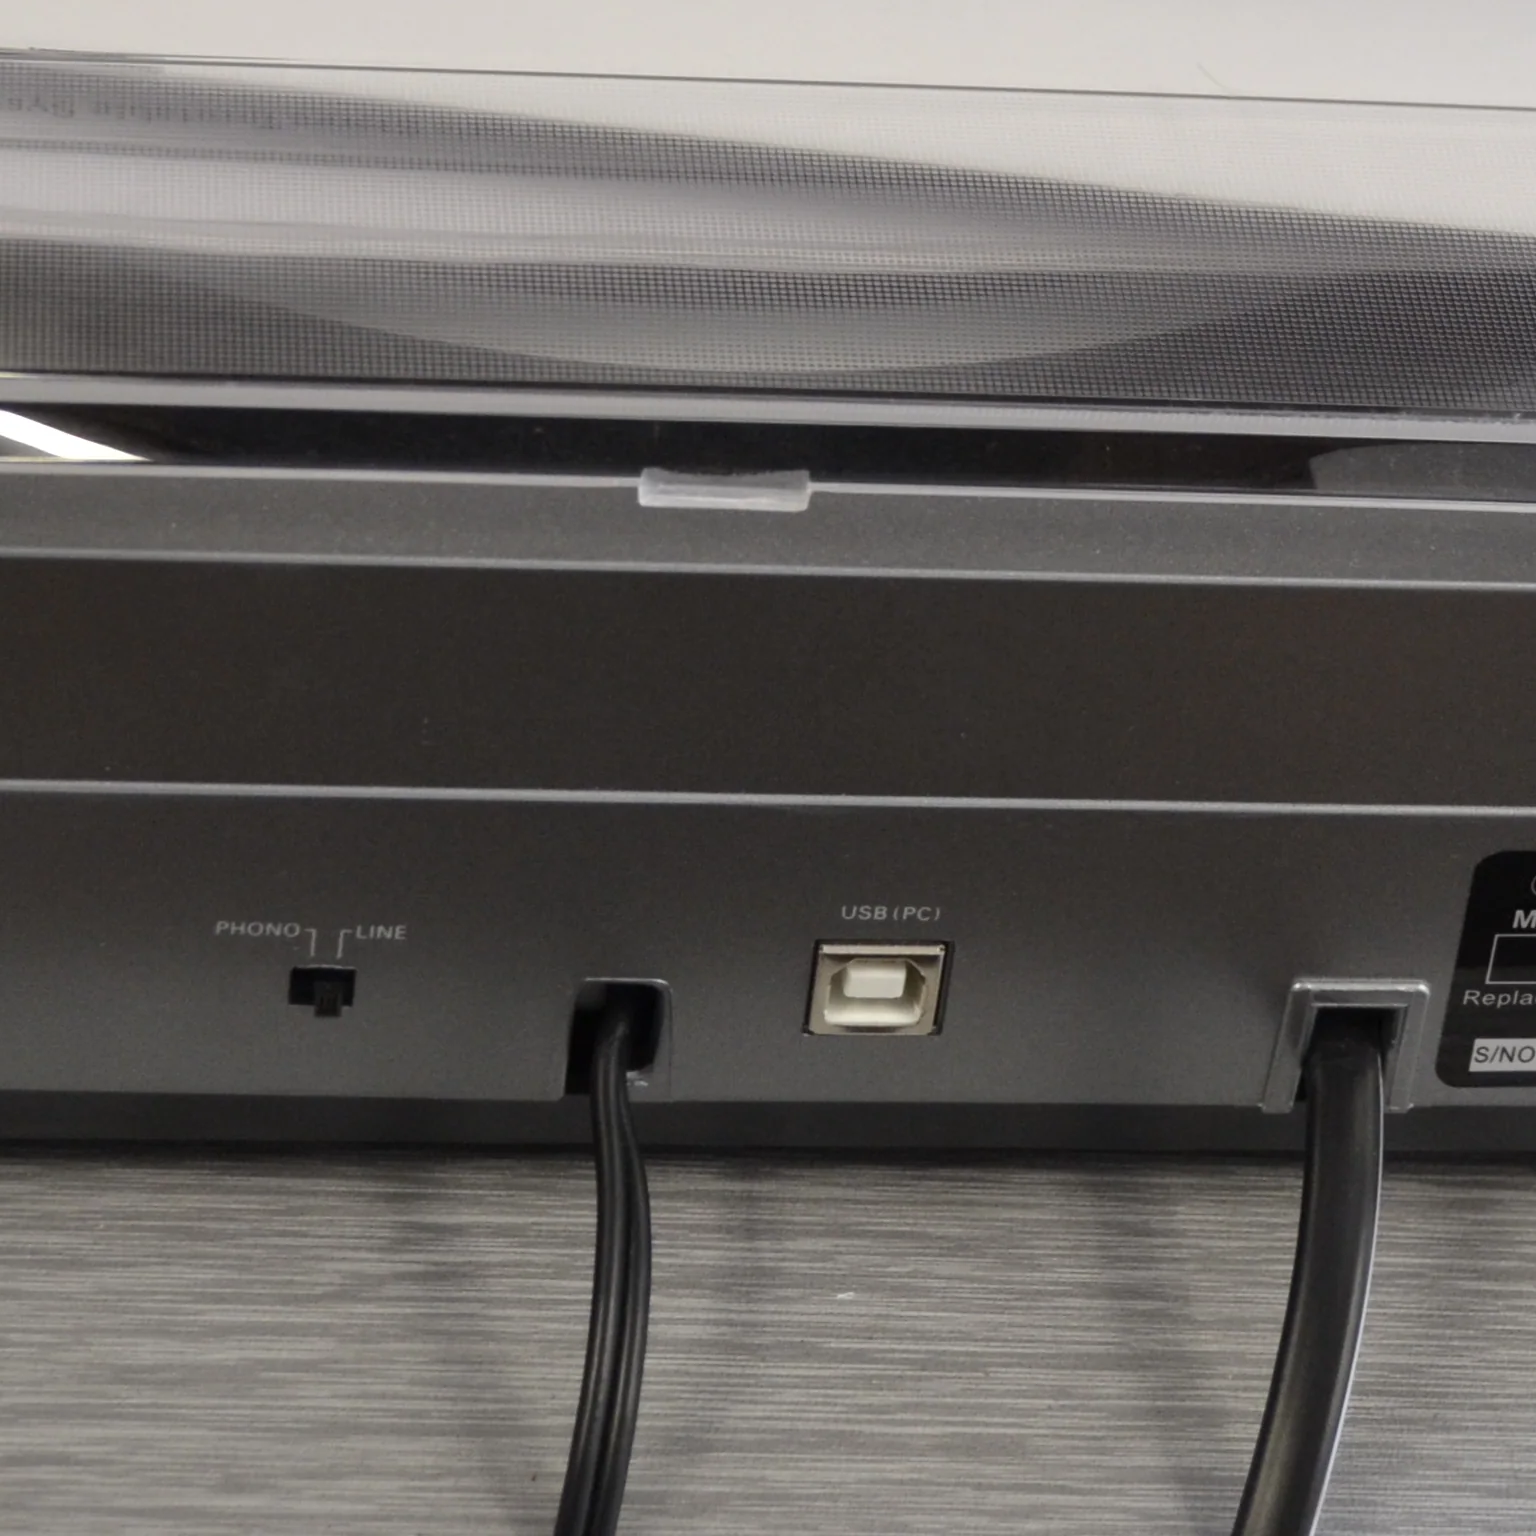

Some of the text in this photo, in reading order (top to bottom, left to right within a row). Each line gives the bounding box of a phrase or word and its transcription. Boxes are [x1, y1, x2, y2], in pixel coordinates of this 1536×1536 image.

[841, 905, 941, 922] USB (PC)
[214, 920, 301, 938] PHONO
[355, 925, 408, 940] LINE
[1474, 1046, 1536, 1063] S/NO
